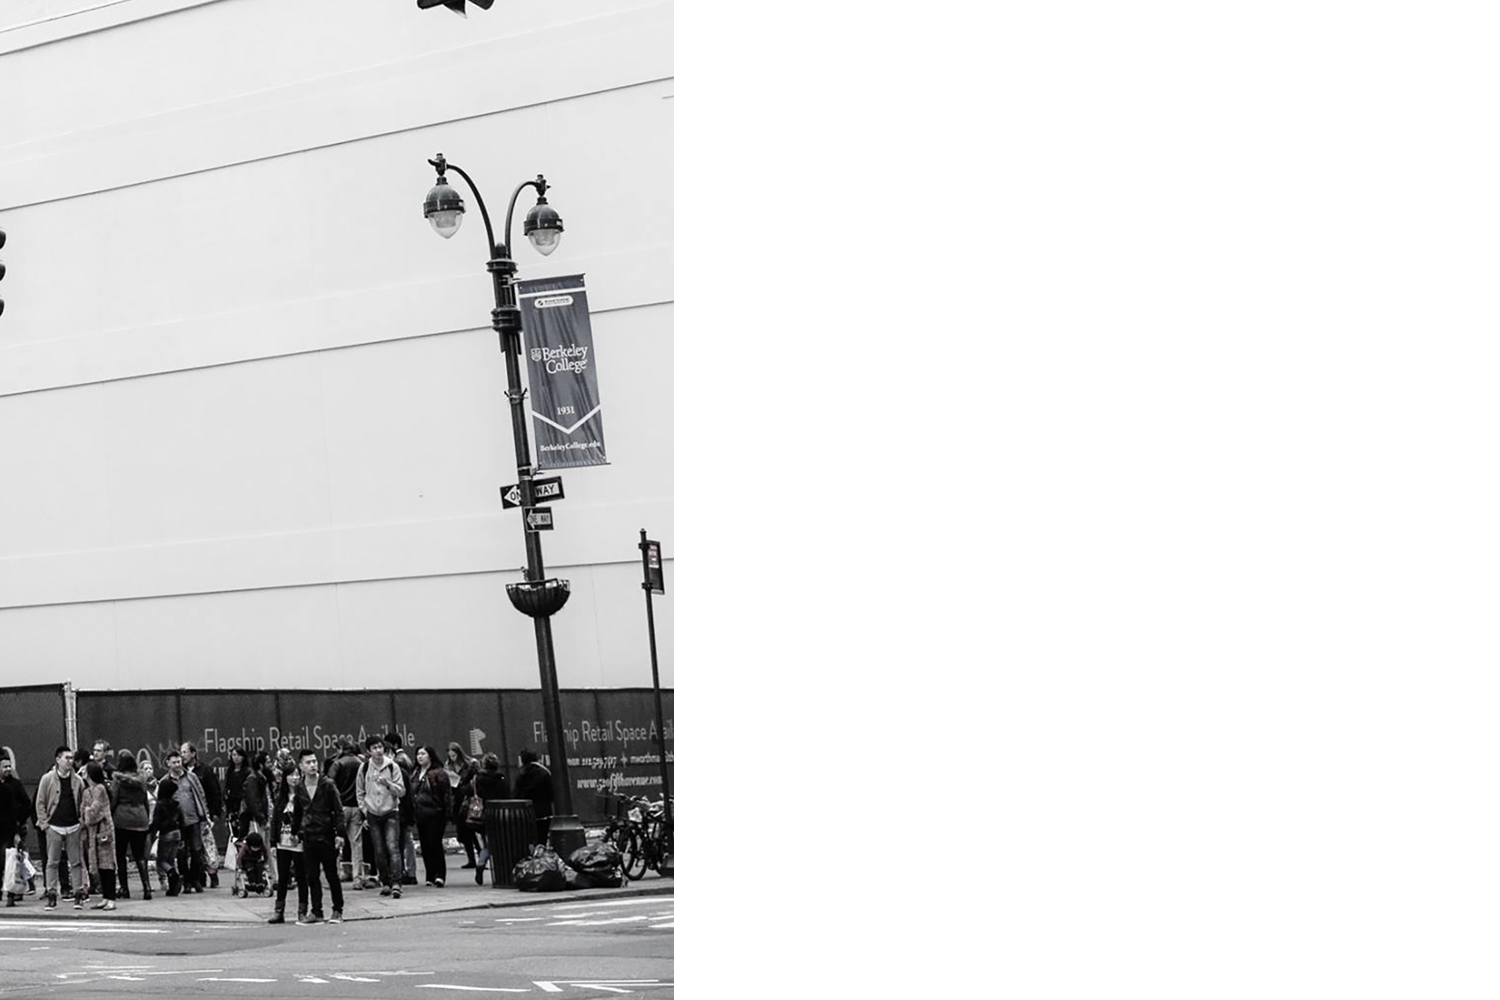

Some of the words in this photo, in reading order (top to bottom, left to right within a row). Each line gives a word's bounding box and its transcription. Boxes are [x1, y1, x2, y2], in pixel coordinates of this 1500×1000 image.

[542, 344, 588, 360] Berkeley
[546, 358, 587, 374] College
[557, 406, 575, 415] 1931
[535, 484, 555, 496] WAY
[204, 728, 265, 757] Flagship
[269, 726, 309, 750] Retail
[313, 725, 354, 758] Spae
[581, 720, 613, 742] Retail
[615, 719, 647, 748] Space
